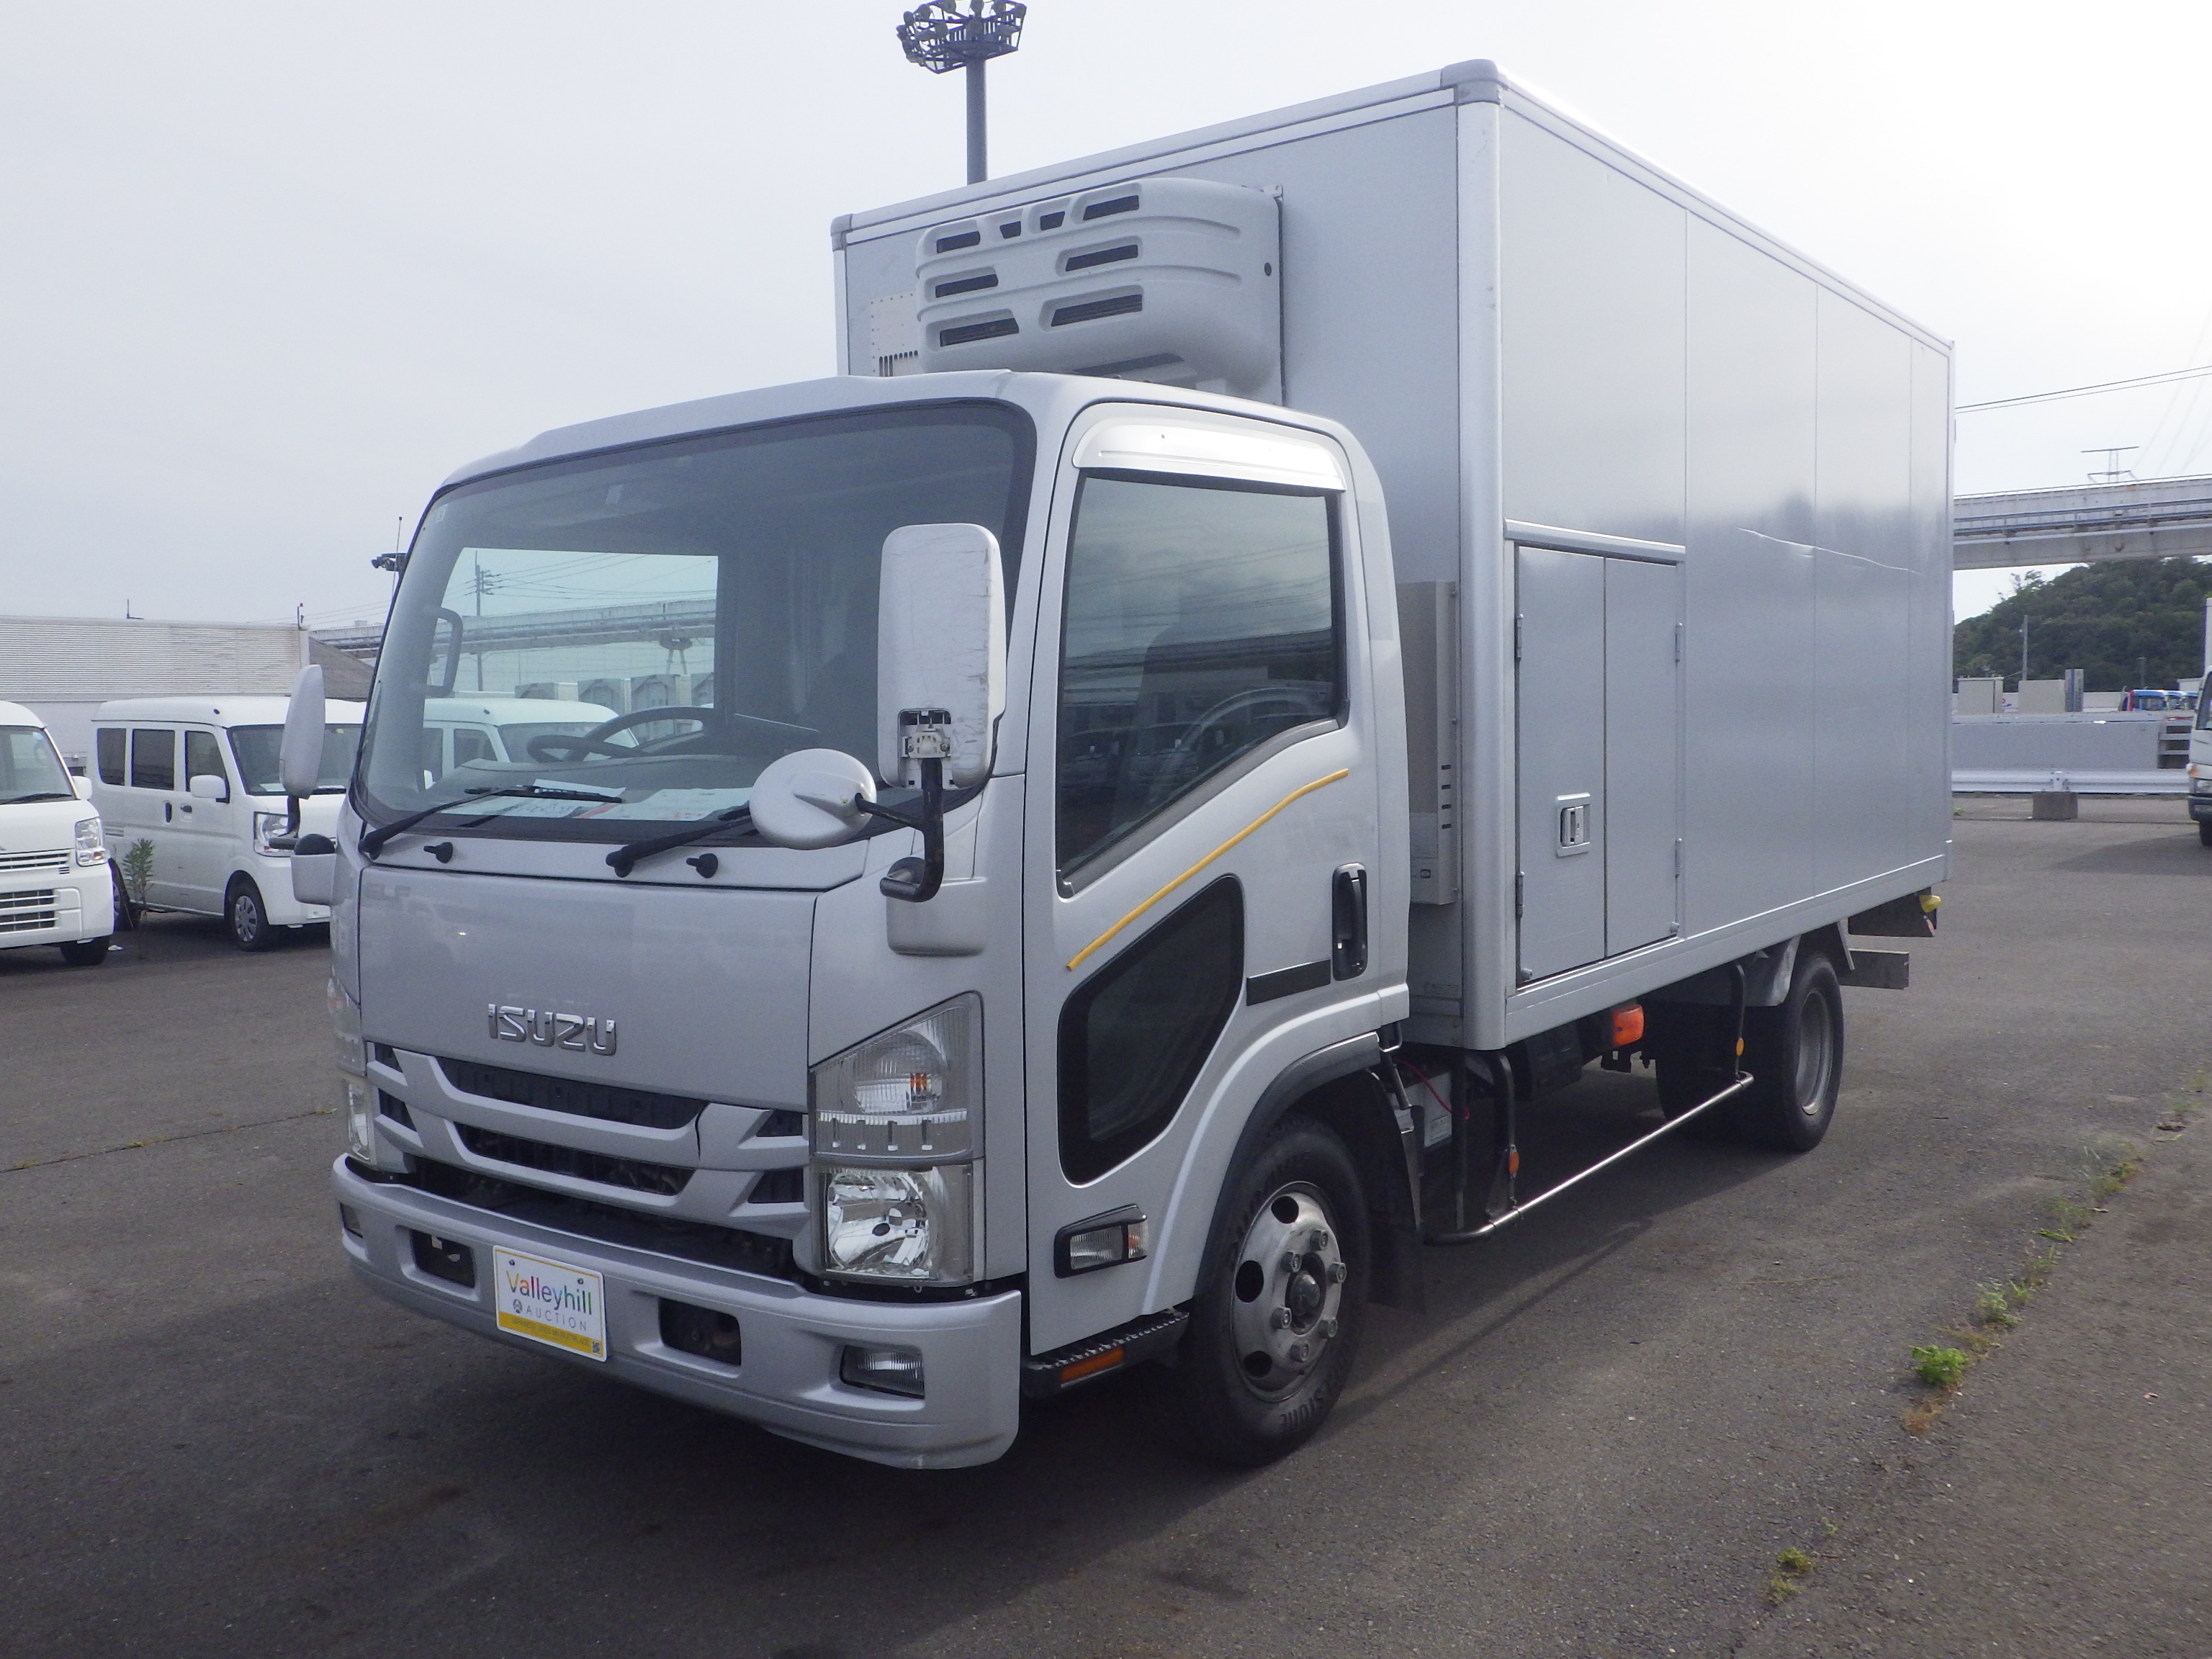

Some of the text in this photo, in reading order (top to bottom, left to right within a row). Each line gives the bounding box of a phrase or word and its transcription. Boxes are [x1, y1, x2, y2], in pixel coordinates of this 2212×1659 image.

[488, 1004, 617, 1056] ISUZU
[506, 1270, 592, 1315] Valleyhill
[526, 1305, 587, 1331] AUCTION
